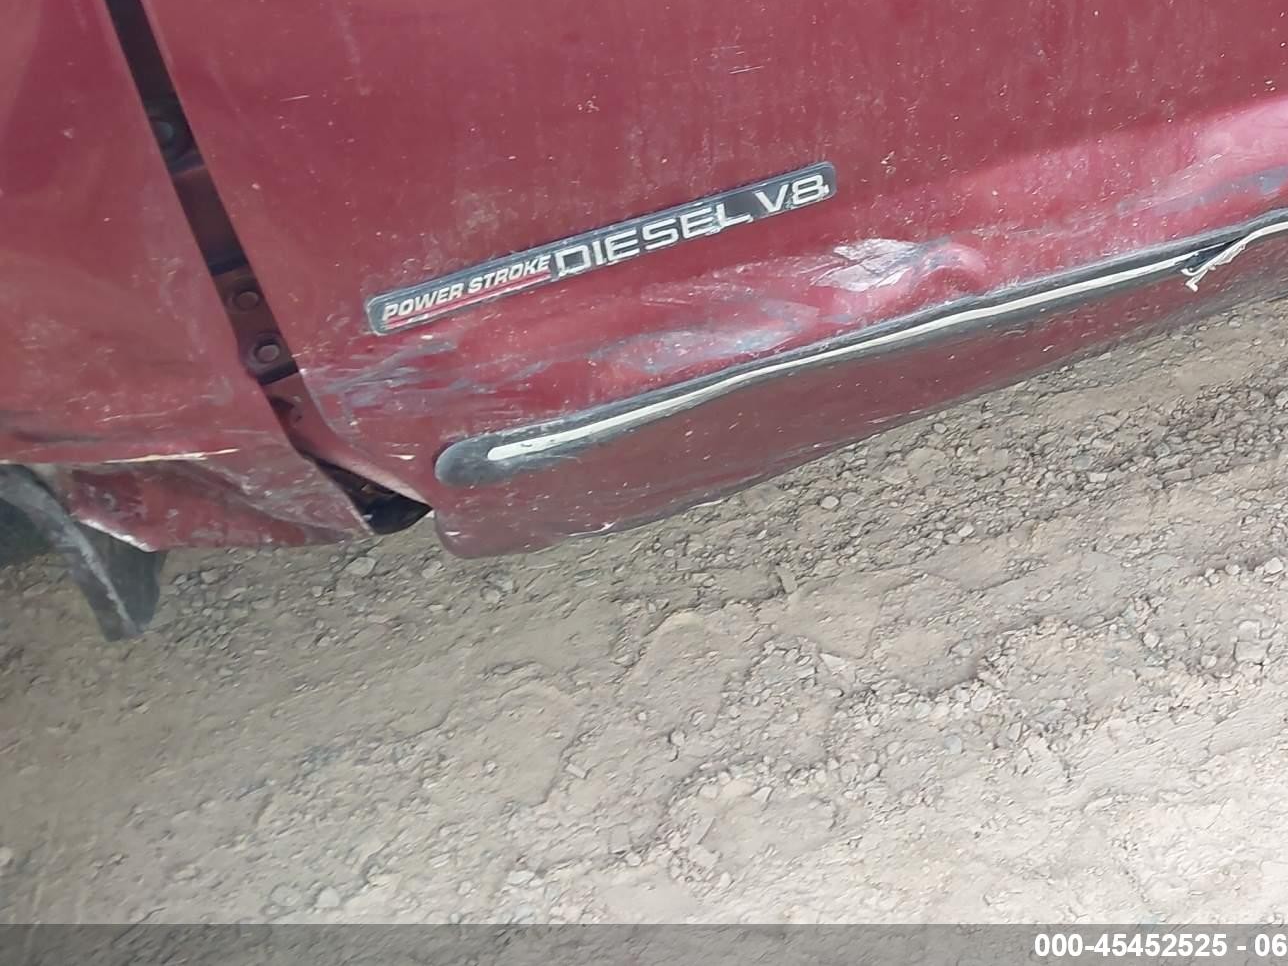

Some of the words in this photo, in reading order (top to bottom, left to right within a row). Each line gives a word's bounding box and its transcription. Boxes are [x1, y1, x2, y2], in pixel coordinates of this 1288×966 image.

[382, 284, 464, 322] POWER
[467, 255, 551, 294] STROKE
[554, 204, 752, 276] DIESEL
[754, 174, 830, 216] V8
